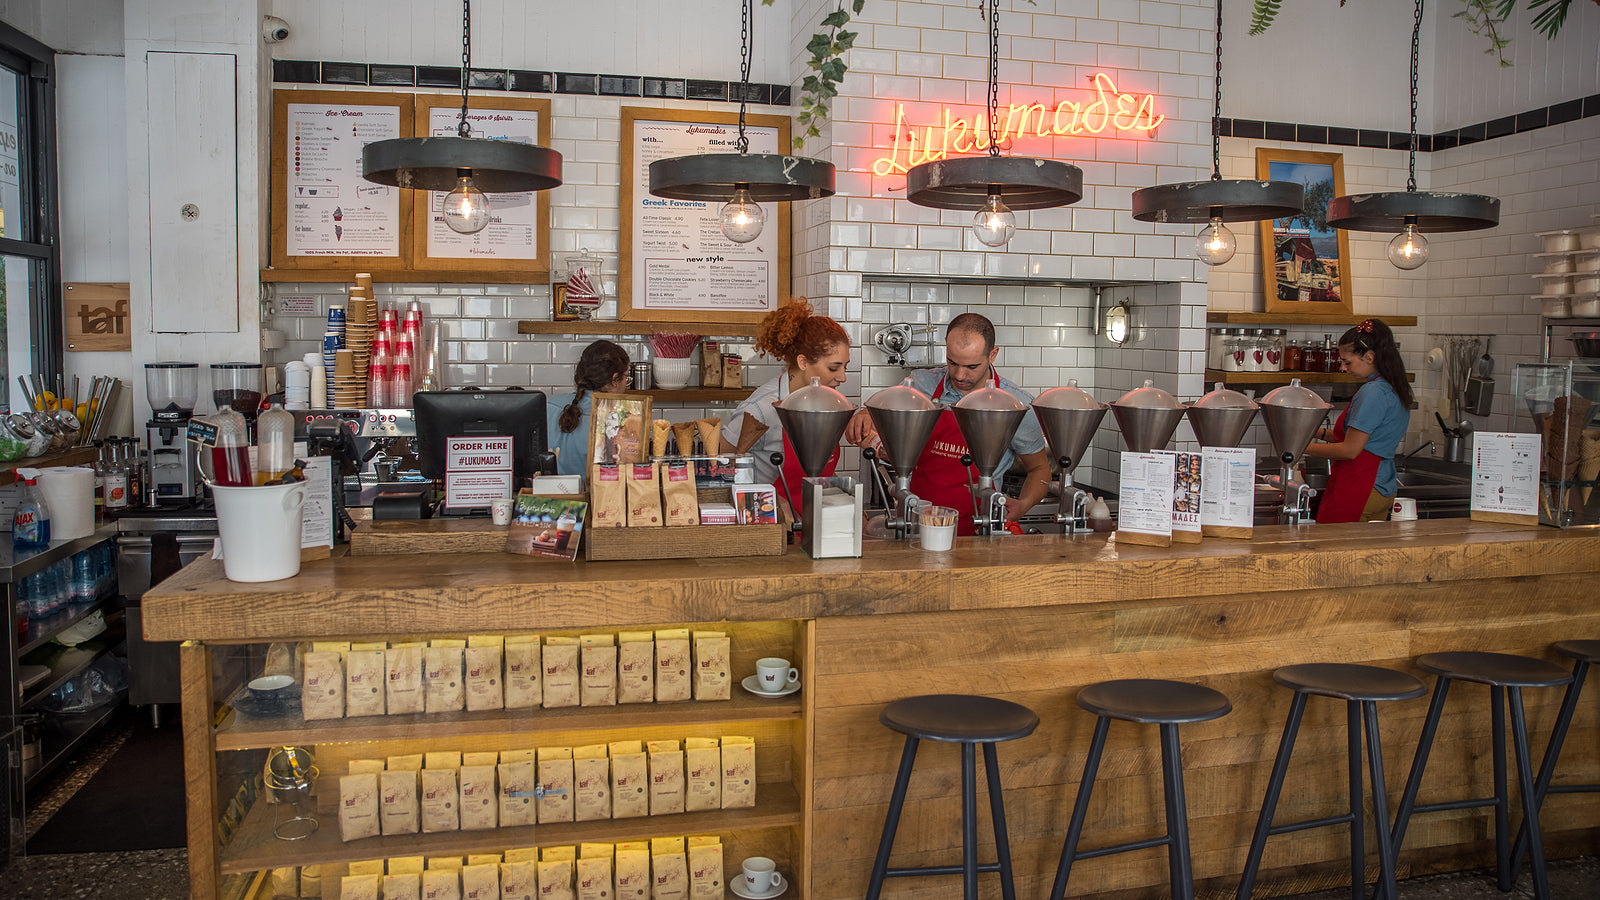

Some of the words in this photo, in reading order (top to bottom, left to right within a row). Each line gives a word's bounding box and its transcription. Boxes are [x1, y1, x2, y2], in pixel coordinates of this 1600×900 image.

[686, 125, 727, 135] Lukumades
[643, 199, 667, 207] Greek
[670, 200, 707, 208] Favorites
[77, 300, 128, 335] taf
[486, 442, 508, 450] HERE
[459, 456, 502, 466] #LUKUMADES
[633, 508, 642, 516] taf
[15, 512, 34, 527] AJAX
[511, 664, 521, 672] taf
[623, 663, 633, 672] taf
[660, 659, 670, 668] taf
[701, 660, 711, 668] taf
[470, 669, 480, 677] taf
[547, 666, 557, 674] taf
[586, 667, 596, 676] taf
[309, 677, 319, 685] taf
[352, 674, 362, 682] taf
[391, 672, 401, 681] taf
[765, 674, 775, 682] taf
[692, 769, 701, 778] taf
[726, 768, 736, 777] taf
[617, 778, 627, 786] taf
[654, 774, 664, 783] taf
[579, 780, 589, 788] taf
[426, 791, 437, 800] taf
[464, 787, 474, 796] taf
[346, 798, 356, 806] taf
[384, 795, 395, 803] taf
[694, 869, 704, 878] taf
[582, 879, 592, 888] taf
[620, 876, 630, 885] taf
[657, 875, 668, 884] taf
[505, 884, 514, 893] taf
[542, 885, 552, 894] taf
[427, 890, 437, 899] taf
[468, 890, 478, 899] taf
